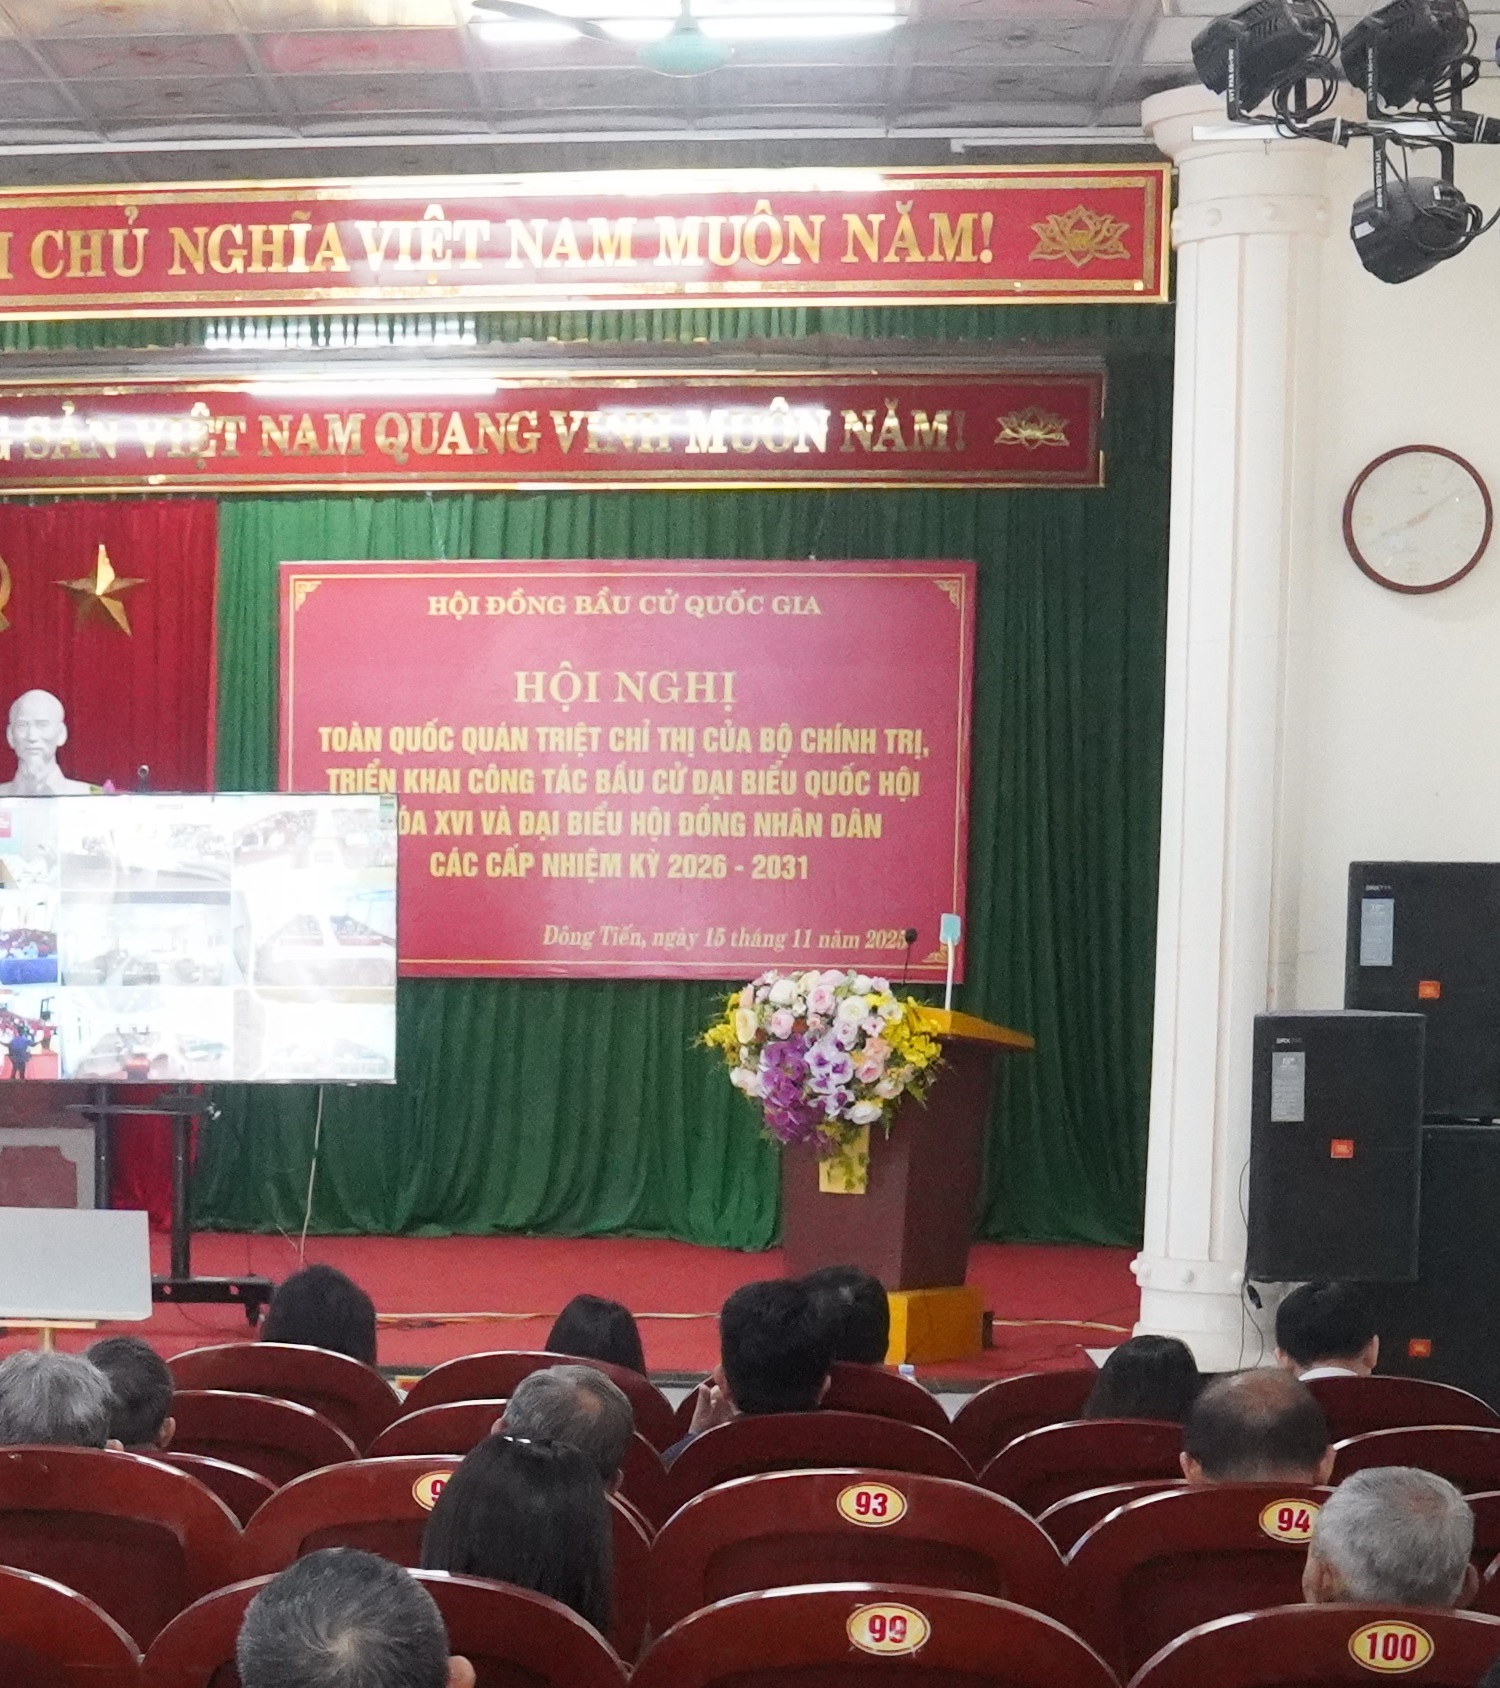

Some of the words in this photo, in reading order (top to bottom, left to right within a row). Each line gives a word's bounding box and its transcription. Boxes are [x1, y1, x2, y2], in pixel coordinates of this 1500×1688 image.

[30, 207, 148, 280] CHỦ
[167, 211, 346, 276] NGHĨA
[355, 207, 491, 286] VIỆT
[505, 220, 634, 270] NAM
[654, 199, 822, 270] MUÔN
[840, 198, 995, 265] NĂM!
[23, 400, 118, 462] SẢN
[134, 401, 246, 470] VIỆT
[258, 412, 363, 457] NAM
[374, 408, 541, 464] QUANG
[549, 409, 672, 456] VINH
[685, 396, 830, 456] MUÔN
[842, 398, 967, 455] NĂM!
[428, 590, 480, 621] HỘI
[485, 587, 567, 615] ĐỒNG
[574, 586, 631, 615] BẦU
[639, 589, 680, 615] CỬ
[685, 588, 764, 619] QUỐC
[772, 595, 822, 615] GIA
[514, 660, 601, 712] HỘI
[613, 671, 736, 712] NGHỊ
[318, 721, 382, 752] TOÀN
[389, 717, 454, 755] QUỐC
[461, 721, 528, 755] QUÁN
[535, 721, 602, 757] TRIỆT
[609, 719, 650, 752] CHỈ
[657, 727, 695, 758] THỊ
[703, 719, 751, 753] CỦA
[760, 723, 792, 759] BỘ
[801, 722, 876, 754] CHÍNH
[884, 729, 930, 759] TRỊ,
[326, 758, 396, 793] TRIỂN
[403, 768, 460, 794] KHAI
[468, 764, 535, 794] CÔNG
[542, 764, 587, 794] TÁC
[595, 760, 644, 795] BẦU
[652, 760, 688, 795] CỬ
[692, 768, 733, 800] ĐẠI
[741, 759, 797, 796] BIỂU
[805, 762, 871, 799] QUỐC
[878, 766, 920, 802] HỘI
[434, 810, 473, 836] XVI
[481, 805, 512, 836] VÀ
[519, 810, 559, 841] ĐẠI
[566, 801, 622, 836] BIỂU
[630, 806, 671, 842] HỘI
[678, 803, 746, 837] ĐỒNG
[753, 807, 823, 837] NHÂN
[830, 807, 882, 839] DÂN
[430, 847, 478, 878] CÁC
[486, 843, 535, 878] CẤP
[541, 848, 621, 884] NHIỆM
[629, 848, 661, 878] KỲ
[668, 854, 727, 879] 2026
[752, 854, 808, 880] 2031
[654, 929, 698, 951] ngày
[730, 927, 785, 951] tháng
[792, 929, 812, 948] 11
[819, 930, 859, 949] năm
[430, 1479, 447, 1503] 9
[854, 1491, 888, 1517] 93
[1276, 1506, 1312, 1534] 94
[867, 1614, 908, 1643] 99
[1365, 1631, 1417, 1662] 100
